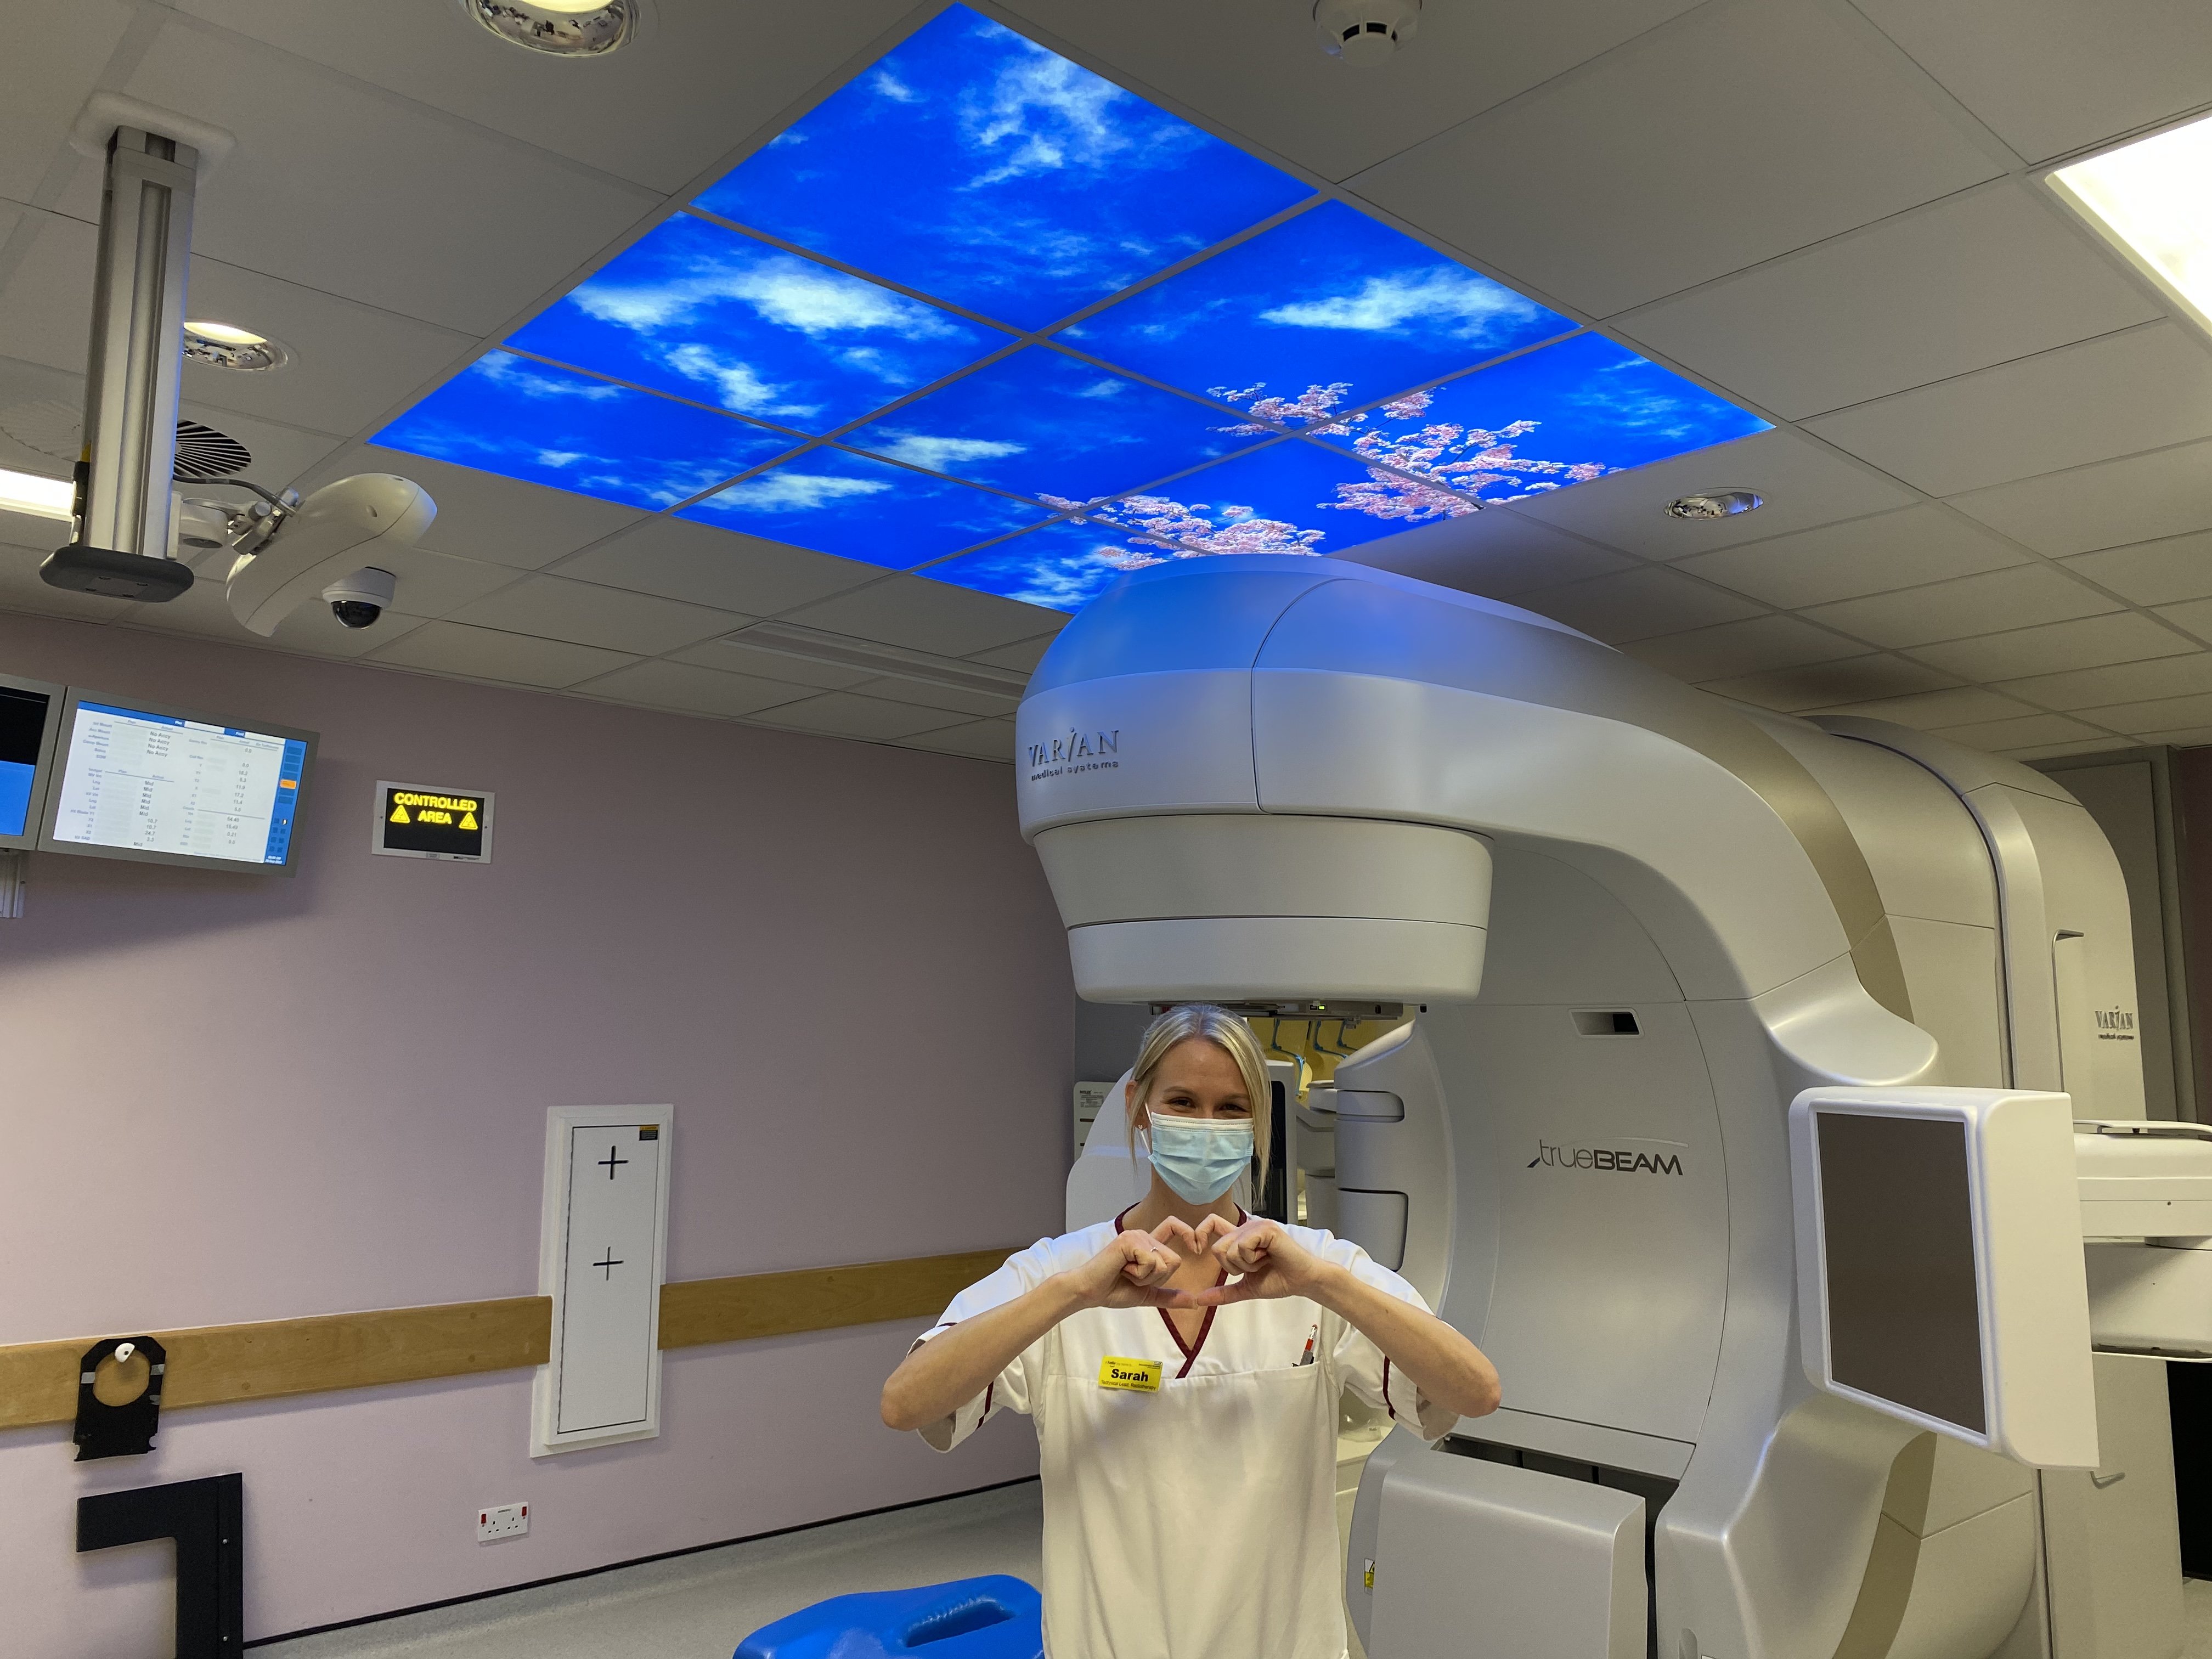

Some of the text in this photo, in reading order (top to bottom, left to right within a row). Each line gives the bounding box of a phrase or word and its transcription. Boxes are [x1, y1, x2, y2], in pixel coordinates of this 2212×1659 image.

[1028, 727, 1119, 767] VARIAN
[1031, 761, 1119, 781] medical systems
[393, 792, 477, 812] CONTROLLED
[417, 810, 452, 825] AREA
[2095, 1005, 2134, 1031] VARIAN
[1539, 1139, 1684, 1176] trueBEAM
[1111, 1368, 1149, 1382] Sarah
